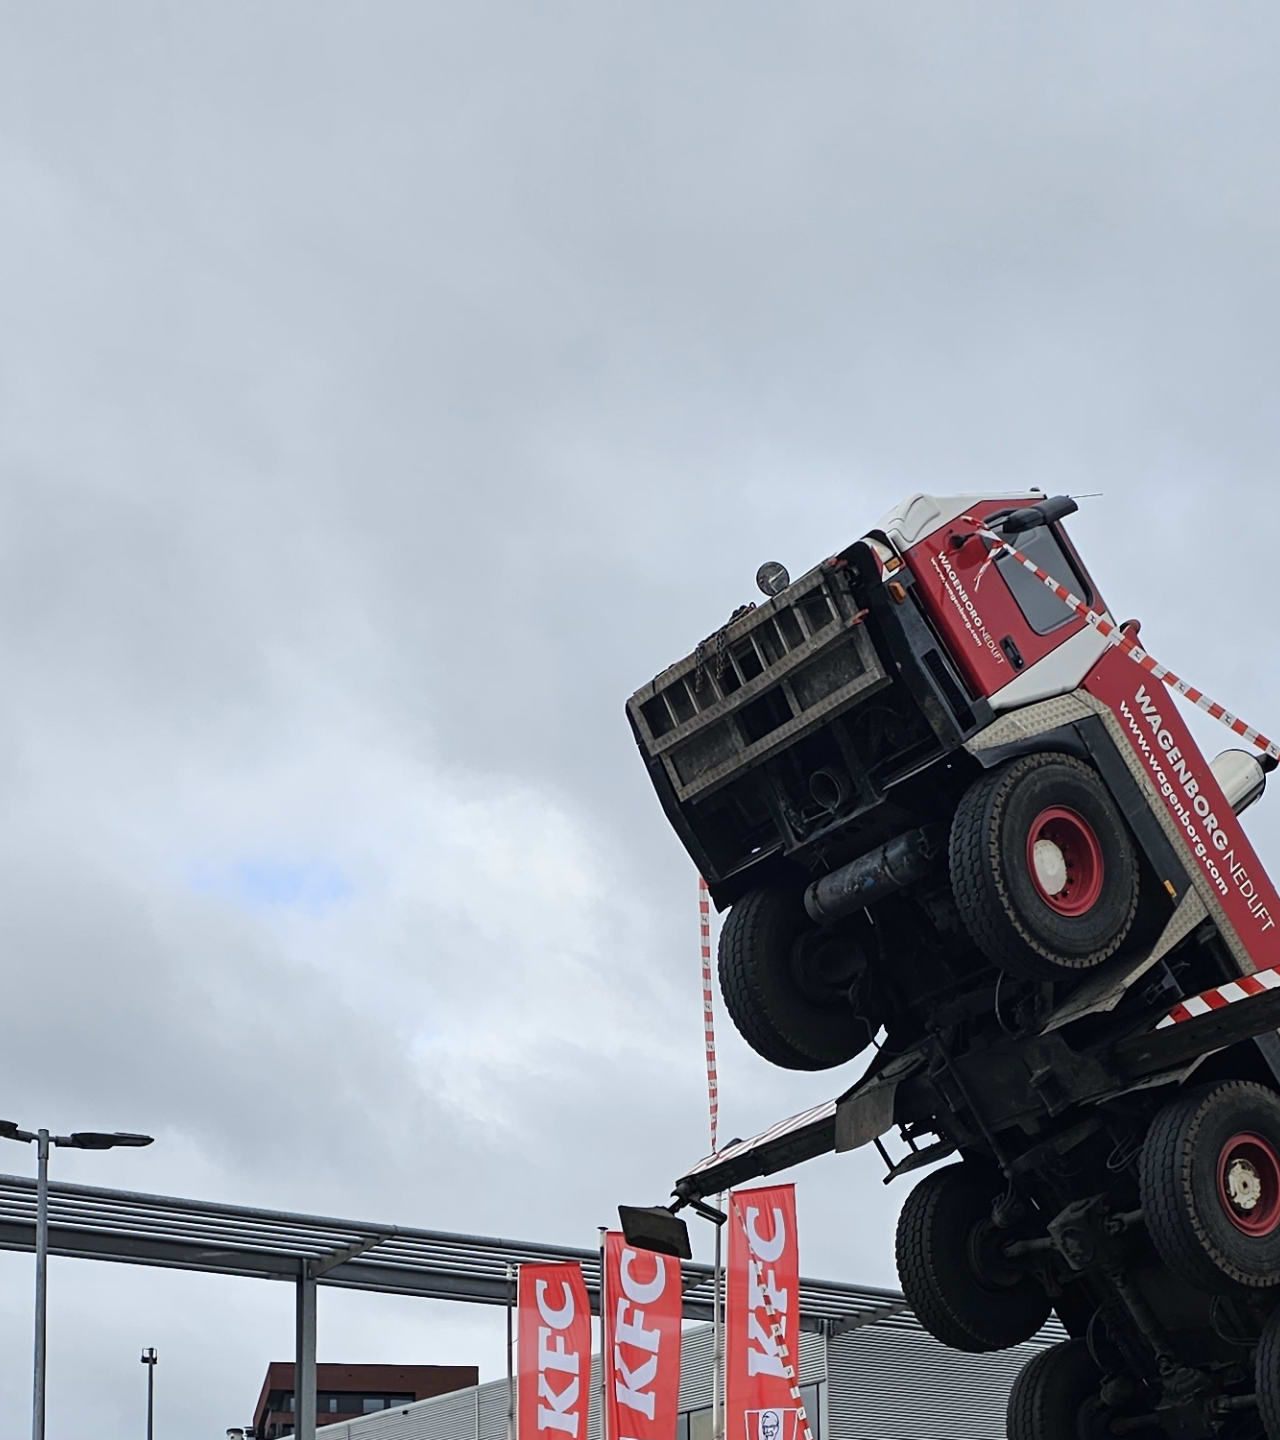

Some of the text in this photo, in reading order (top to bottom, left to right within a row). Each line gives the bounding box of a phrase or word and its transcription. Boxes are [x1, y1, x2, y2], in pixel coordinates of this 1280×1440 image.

[931, 557, 982, 647] www.wagenborg.com
[938, 551, 1005, 664] WAGENBORG NEDLIFT
[1120, 700, 1228, 896] www.wagenborg.com
[1134, 684, 1275, 932] WAGENBORG NEDLIFT
[536, 1279, 579, 1439] KFC
[615, 1248, 666, 1420] KFC
[746, 1206, 787, 1379] KFC
